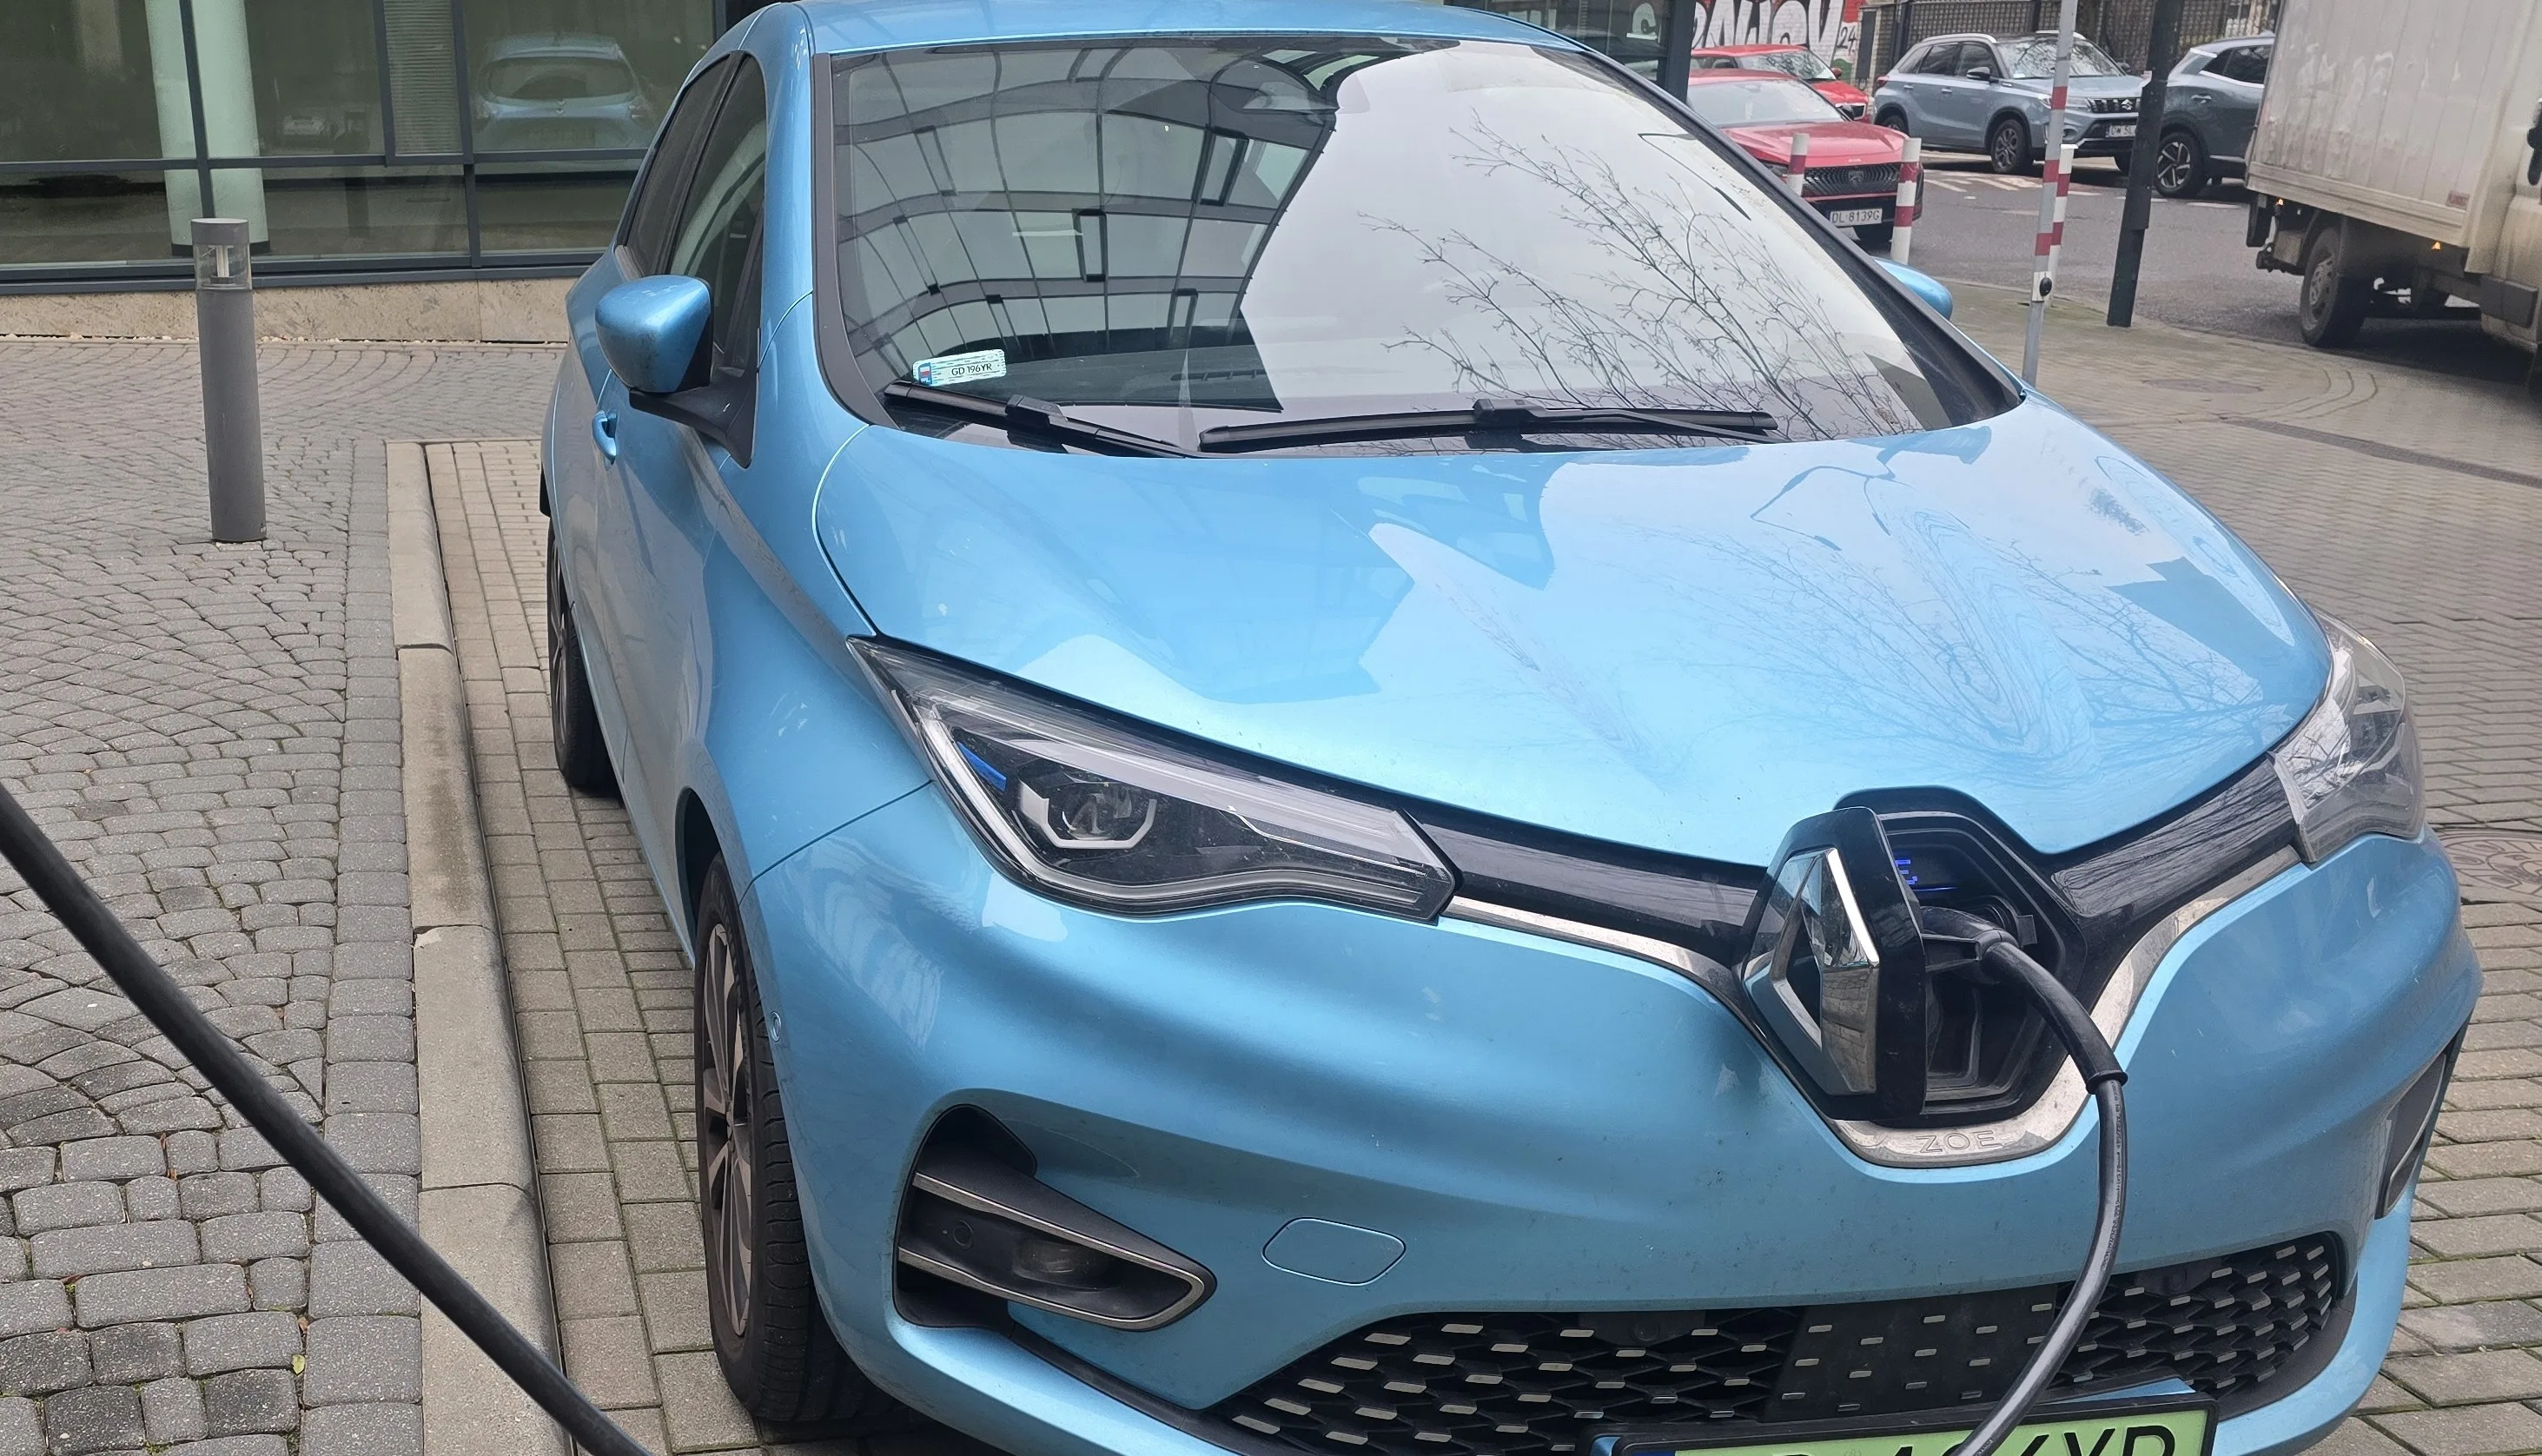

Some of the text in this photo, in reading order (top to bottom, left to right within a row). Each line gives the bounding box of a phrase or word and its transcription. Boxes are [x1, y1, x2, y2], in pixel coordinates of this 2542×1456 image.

[1831, 212, 1844, 223] DL
[951, 363, 992, 375] GD 196YR
[1916, 1130, 2001, 1154] ZOE
